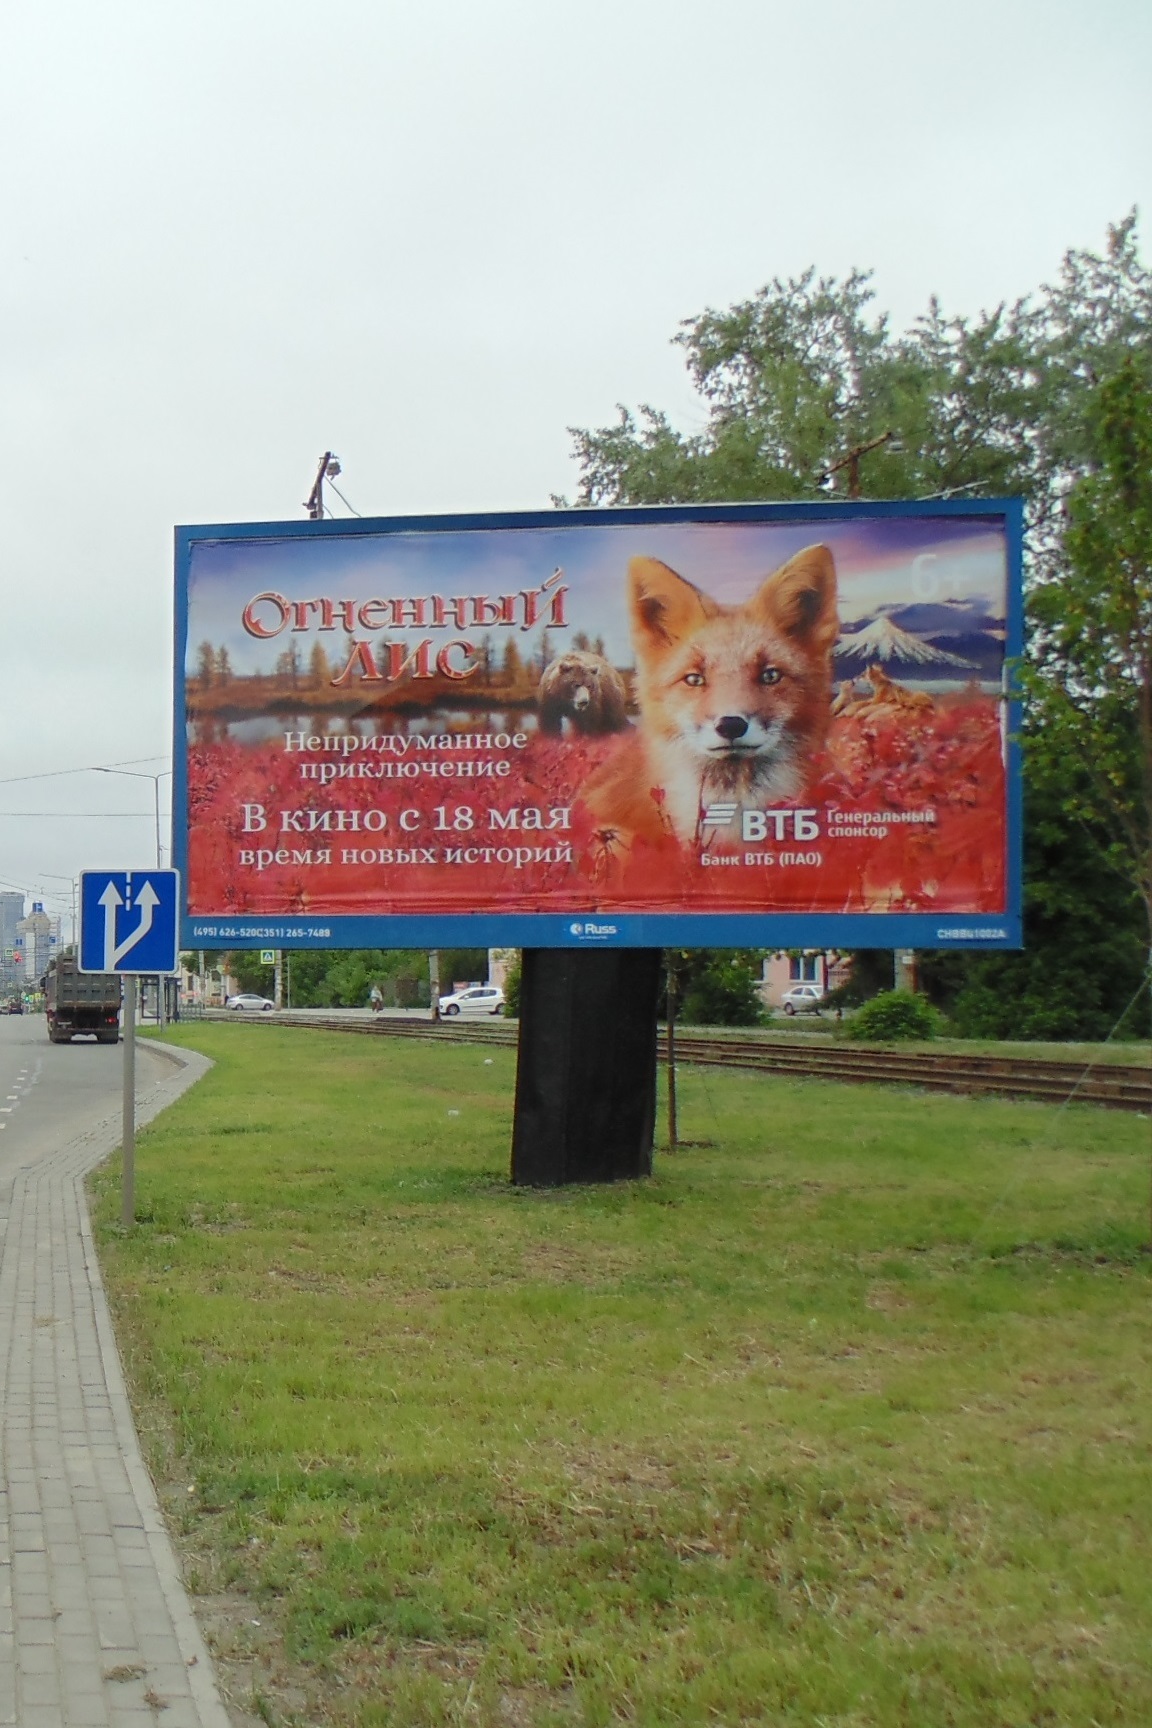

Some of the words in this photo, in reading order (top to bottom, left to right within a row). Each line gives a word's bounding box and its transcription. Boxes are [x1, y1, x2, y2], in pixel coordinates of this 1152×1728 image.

[242, 567, 570, 638] Огненный
[284, 730, 528, 756] Непридуманное
[300, 759, 511, 784] приключение
[241, 803, 267, 833] В
[279, 807, 388, 833] кино
[399, 808, 421, 832] с
[432, 805, 475, 831] 18
[487, 806, 572, 831] мая
[742, 809, 820, 842] ВТБ
[827, 808, 936, 826] Генеральный
[827, 825, 889, 841] спонсор
[239, 847, 332, 870] время
[340, 847, 437, 866] новых
[444, 841, 573, 868] историй
[701, 853, 740, 867] Банк
[744, 852, 775, 867] ВТБ
[778, 851, 823, 868] (ПАО)
[193, 926, 218, 937] (495)
